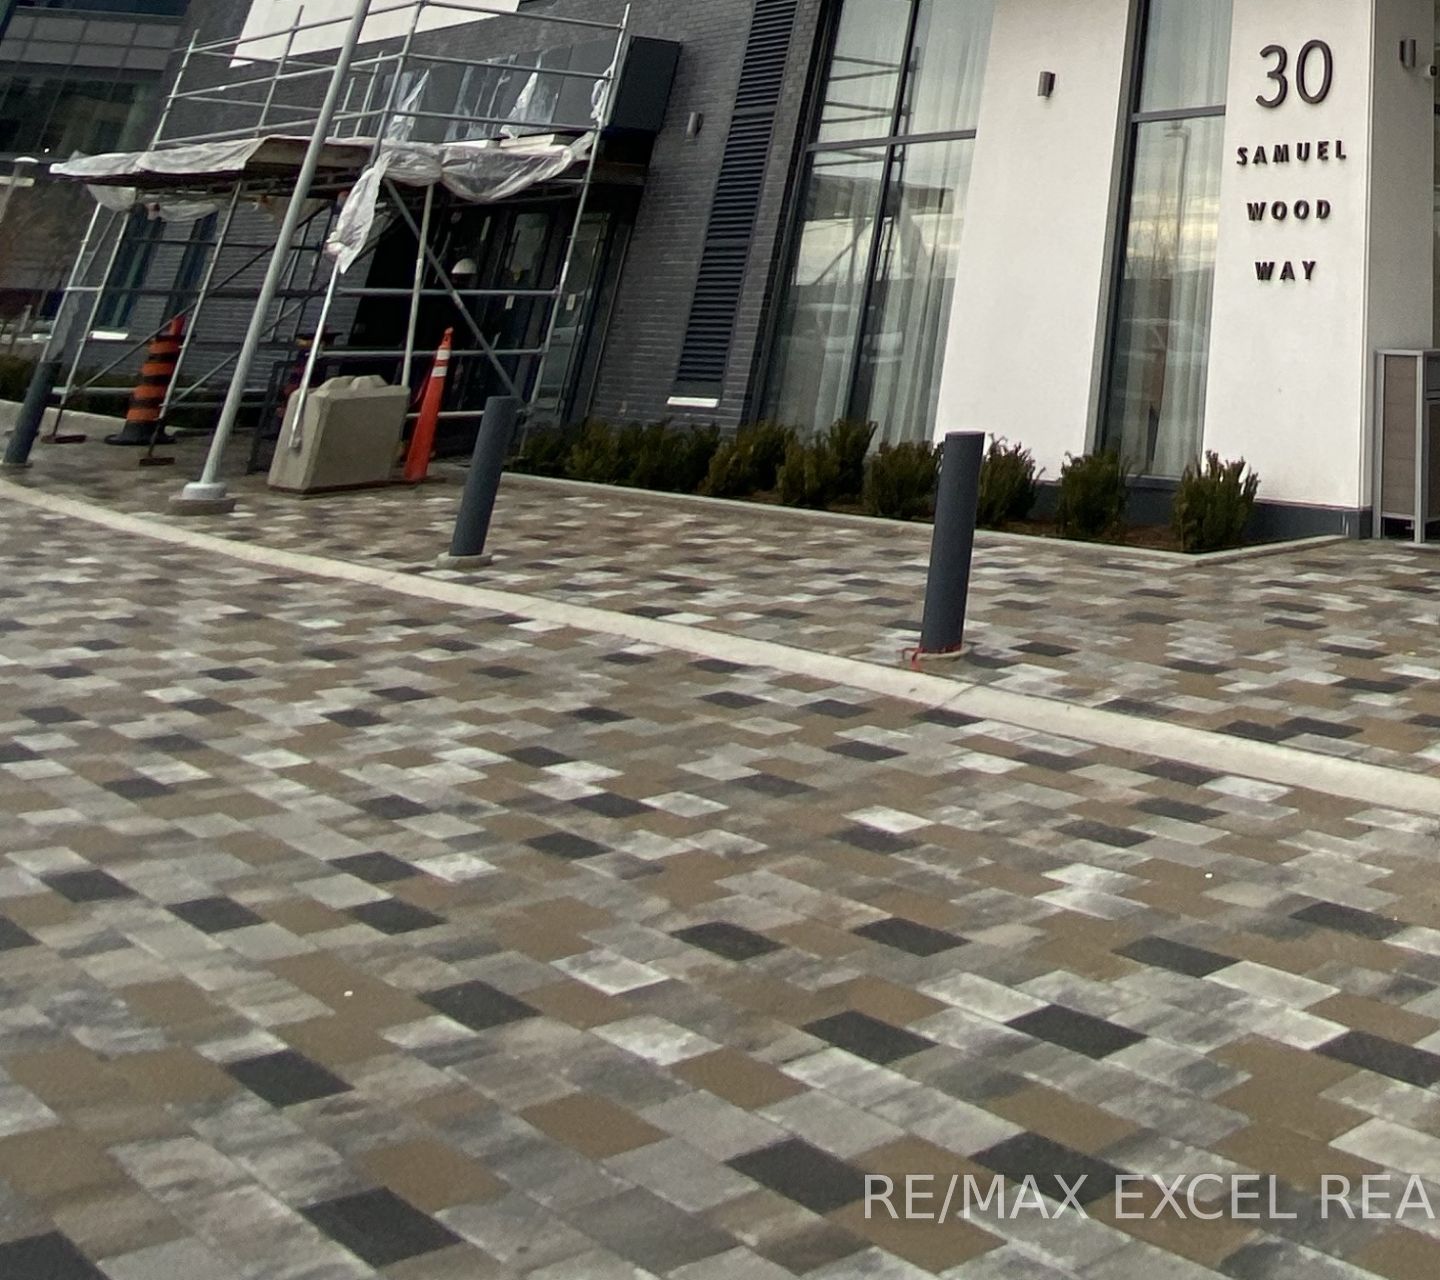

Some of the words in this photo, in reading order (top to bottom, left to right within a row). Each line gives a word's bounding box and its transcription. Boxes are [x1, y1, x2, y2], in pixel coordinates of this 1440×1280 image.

[1255, 39, 1333, 108] 30
[1236, 140, 1346, 166] SAMUEL
[1247, 200, 1331, 221] WOOD
[1255, 260, 1317, 281] WAY
